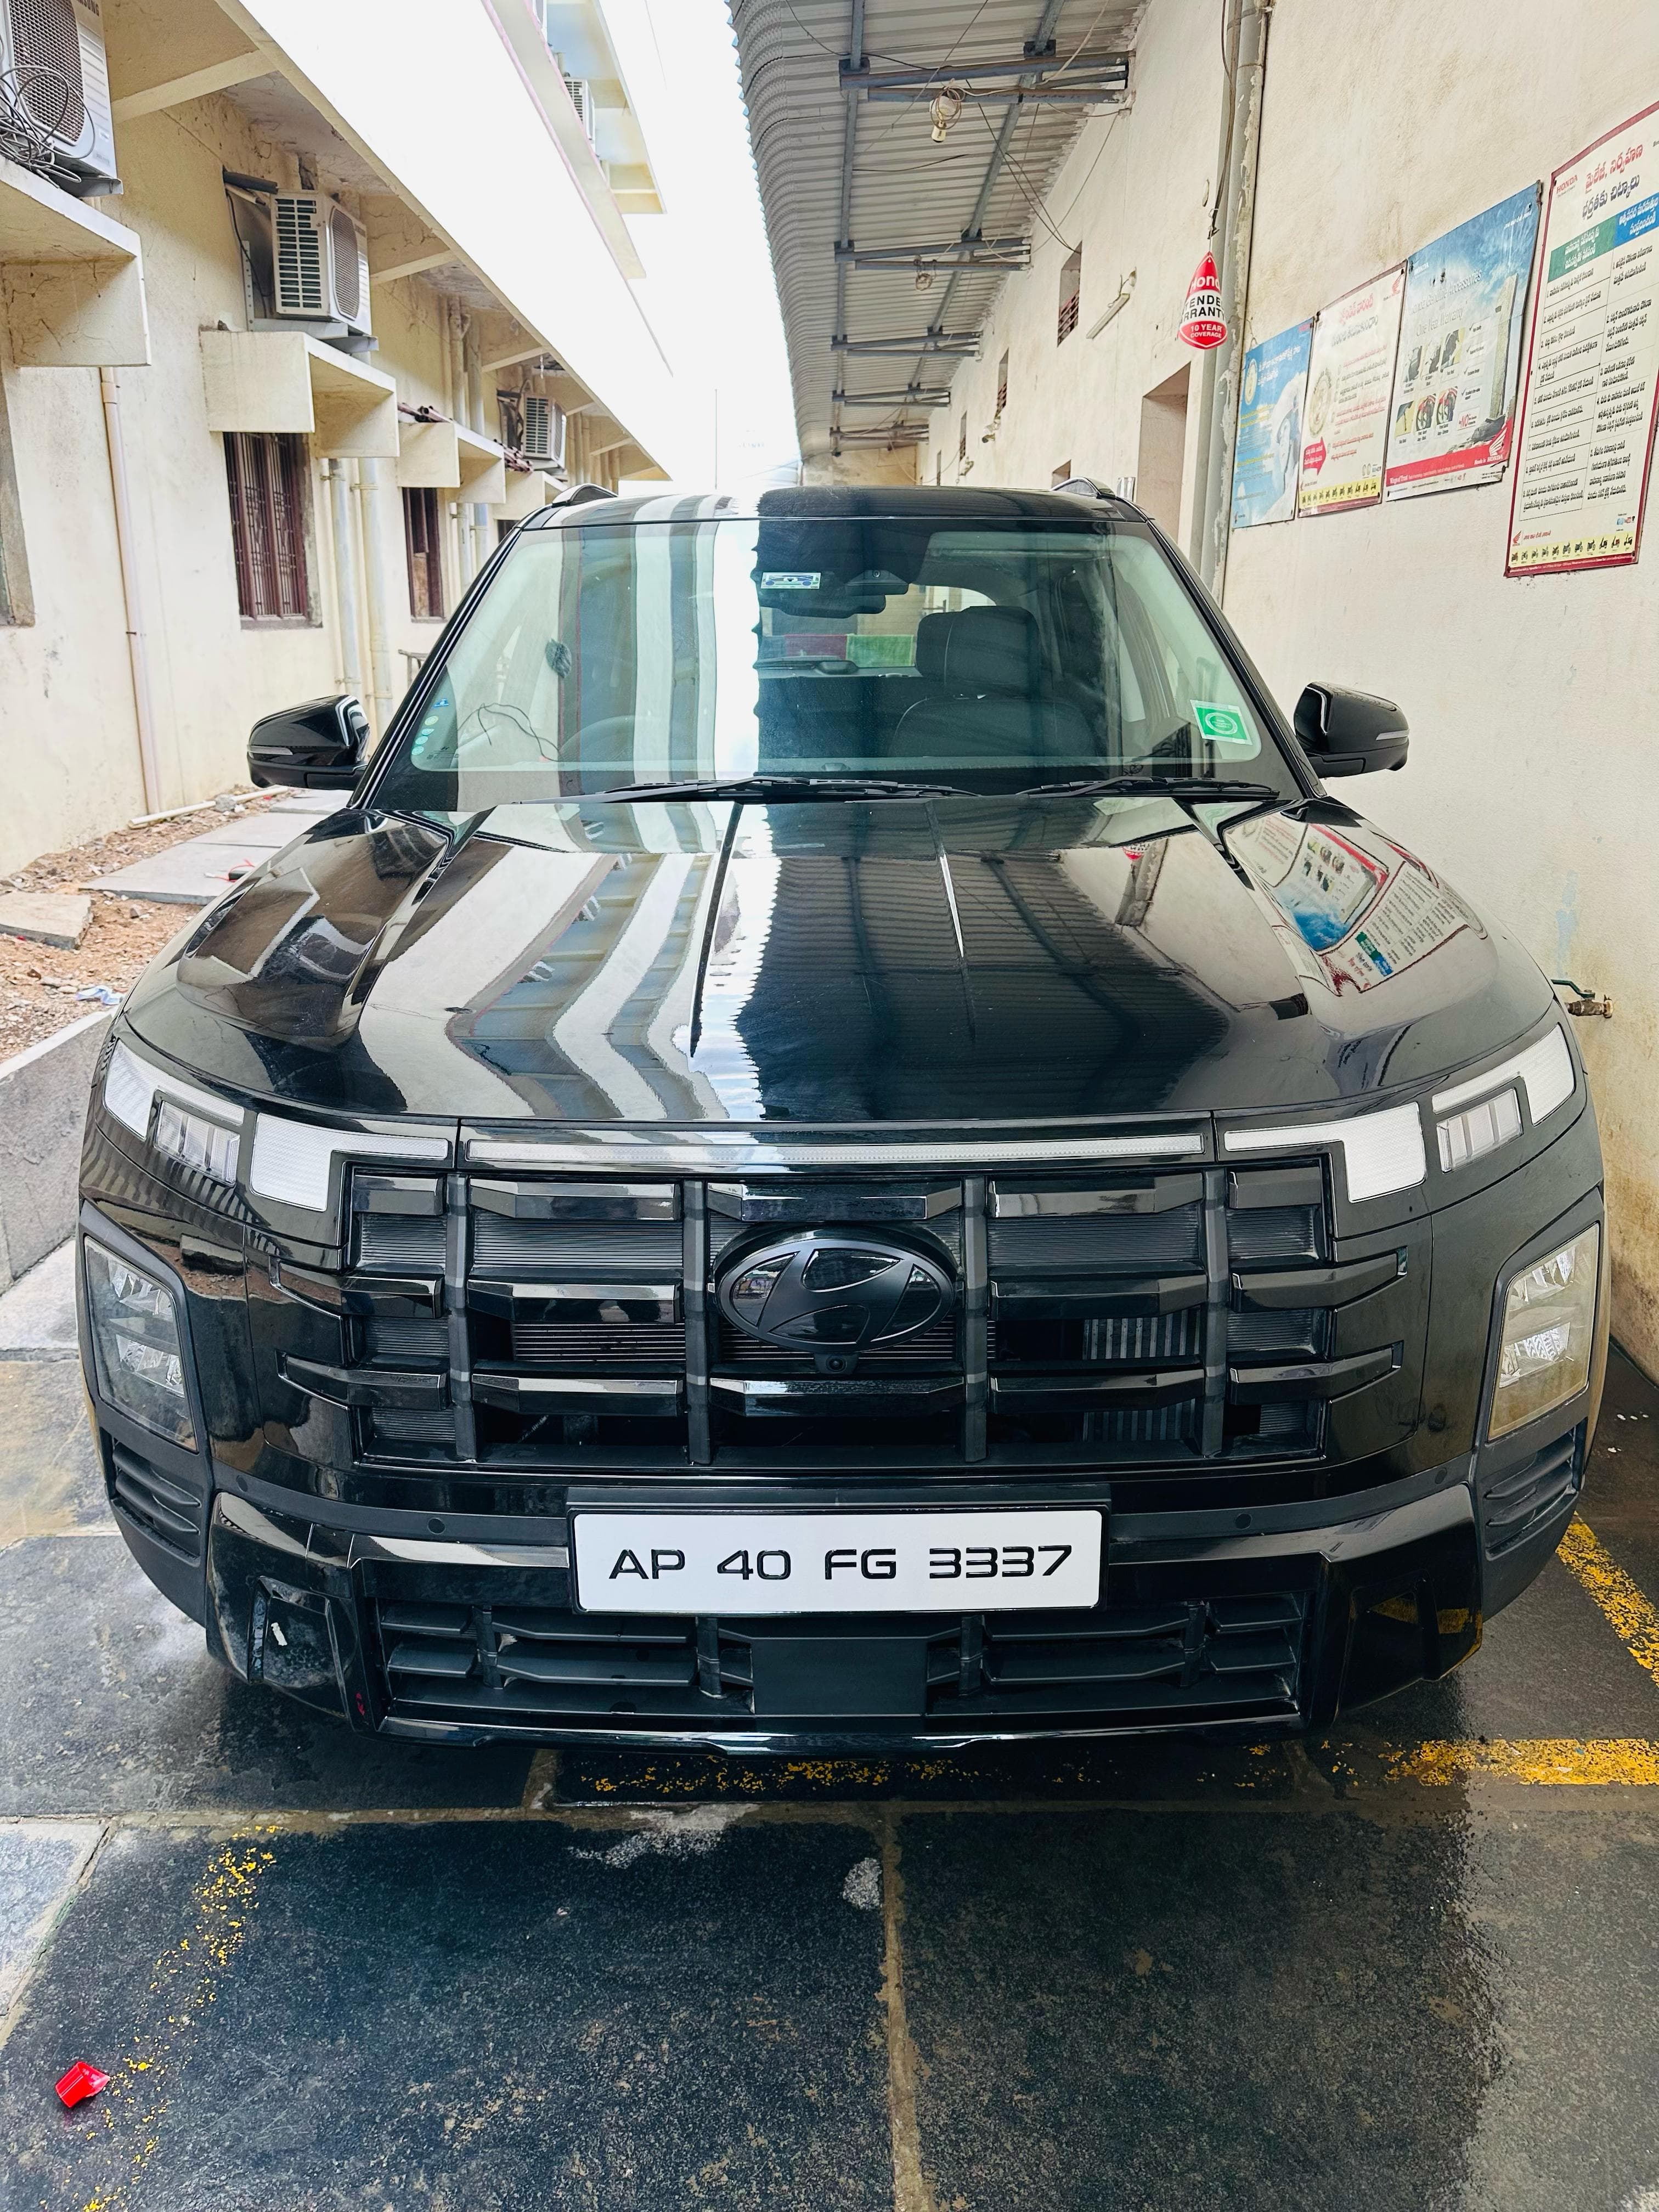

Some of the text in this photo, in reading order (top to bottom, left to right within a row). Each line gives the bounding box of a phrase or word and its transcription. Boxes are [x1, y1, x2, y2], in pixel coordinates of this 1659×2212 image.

[1556, 174, 1578, 194] HONDA
[1201, 324, 1222, 332] YEAR
[609, 1544, 1072, 1580] AP 40 FG 3337
